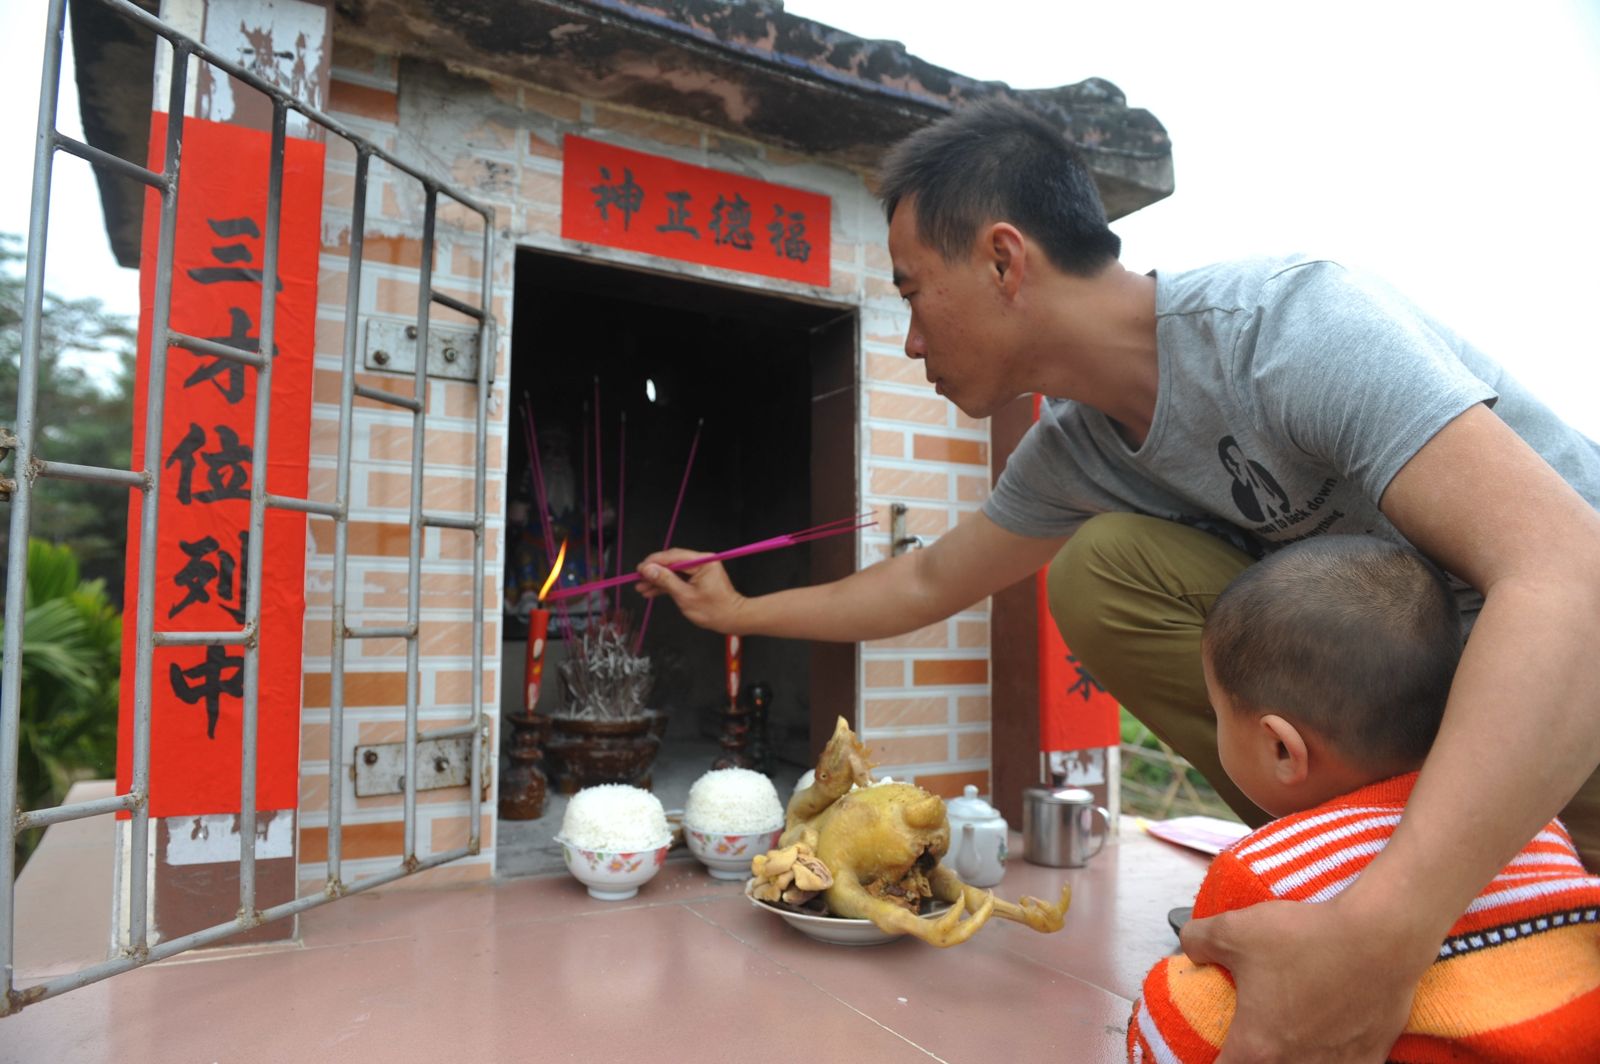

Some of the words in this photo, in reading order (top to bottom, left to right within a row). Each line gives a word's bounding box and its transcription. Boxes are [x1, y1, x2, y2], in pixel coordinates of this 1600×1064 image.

[165, 216, 283, 740] 三才位列中
[1306, 476, 1338, 512] down
